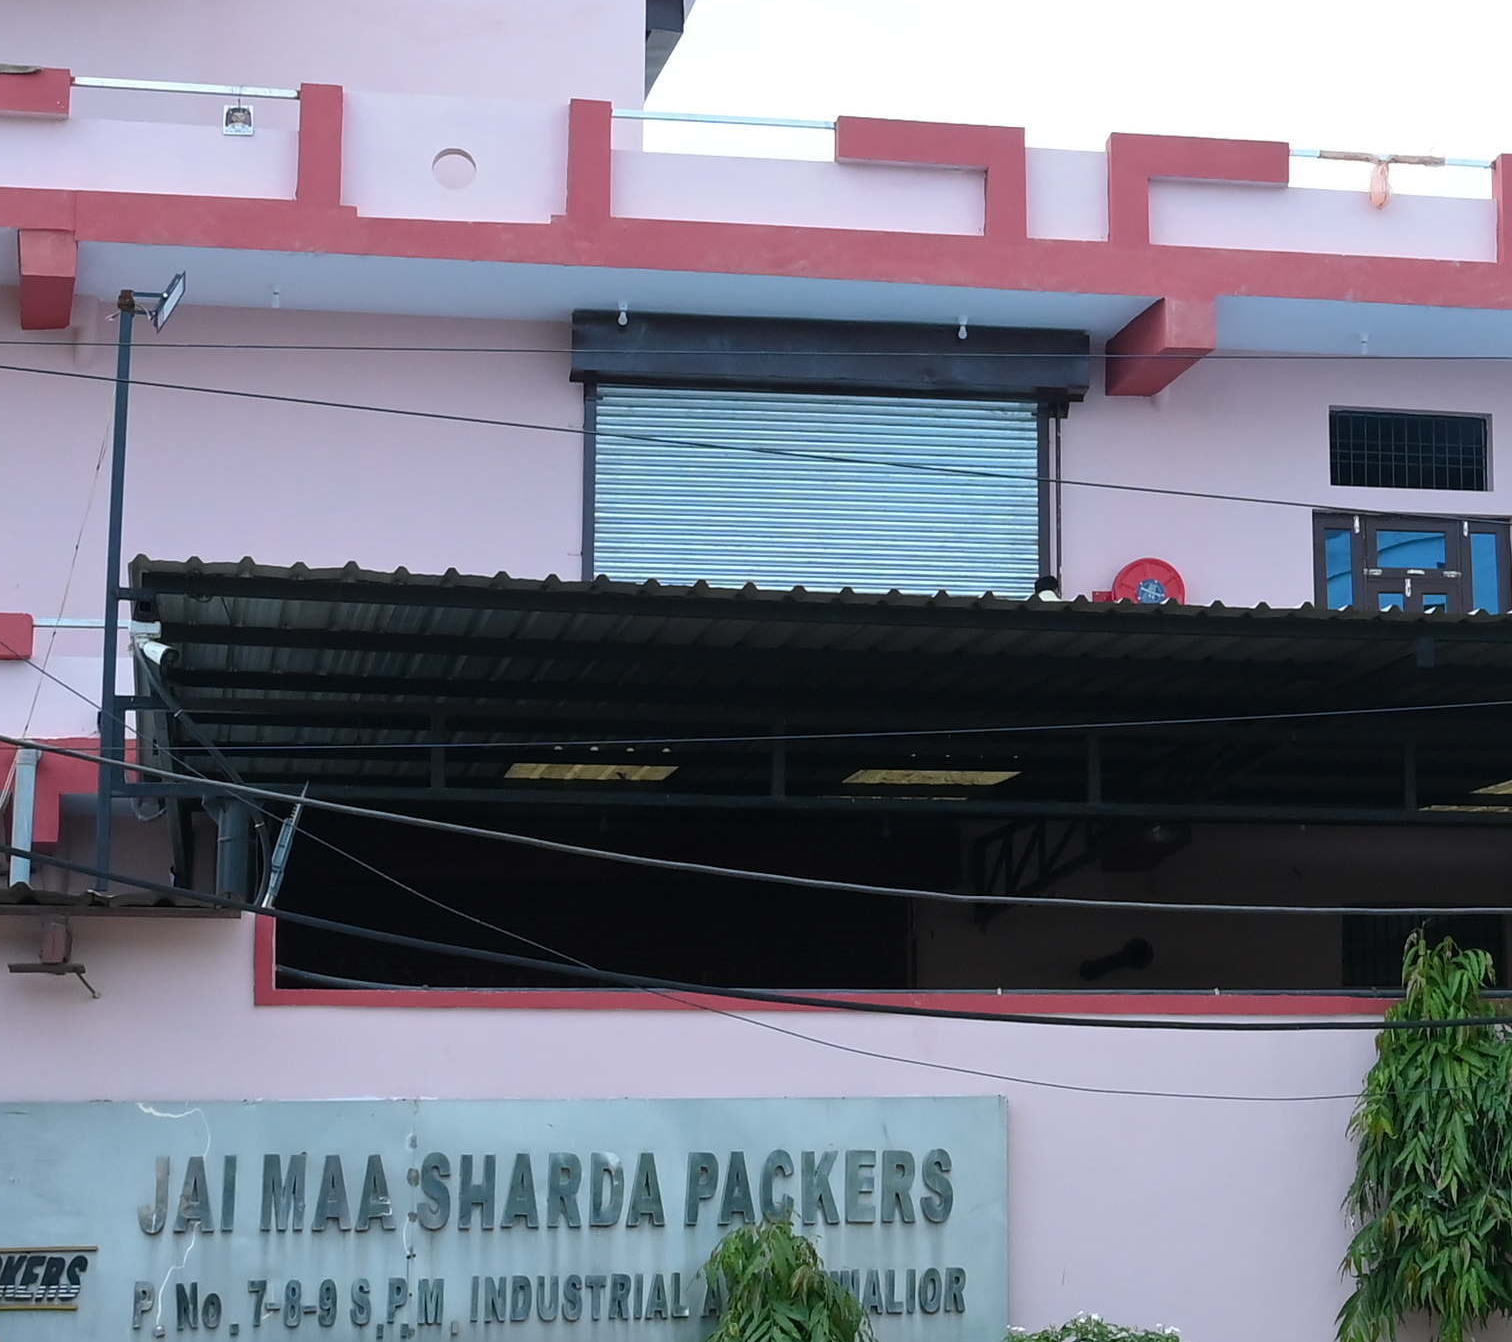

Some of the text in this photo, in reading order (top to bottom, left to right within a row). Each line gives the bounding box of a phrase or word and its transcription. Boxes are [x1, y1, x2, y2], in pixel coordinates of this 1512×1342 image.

[137, 1148, 954, 1235] JAI MAA SHARDA PACKERS
[247, 1278, 337, 1328] 7-8-9
[470, 1272, 690, 1323] INDUSTRIAL
[829, 1267, 967, 1316] WALIOR
